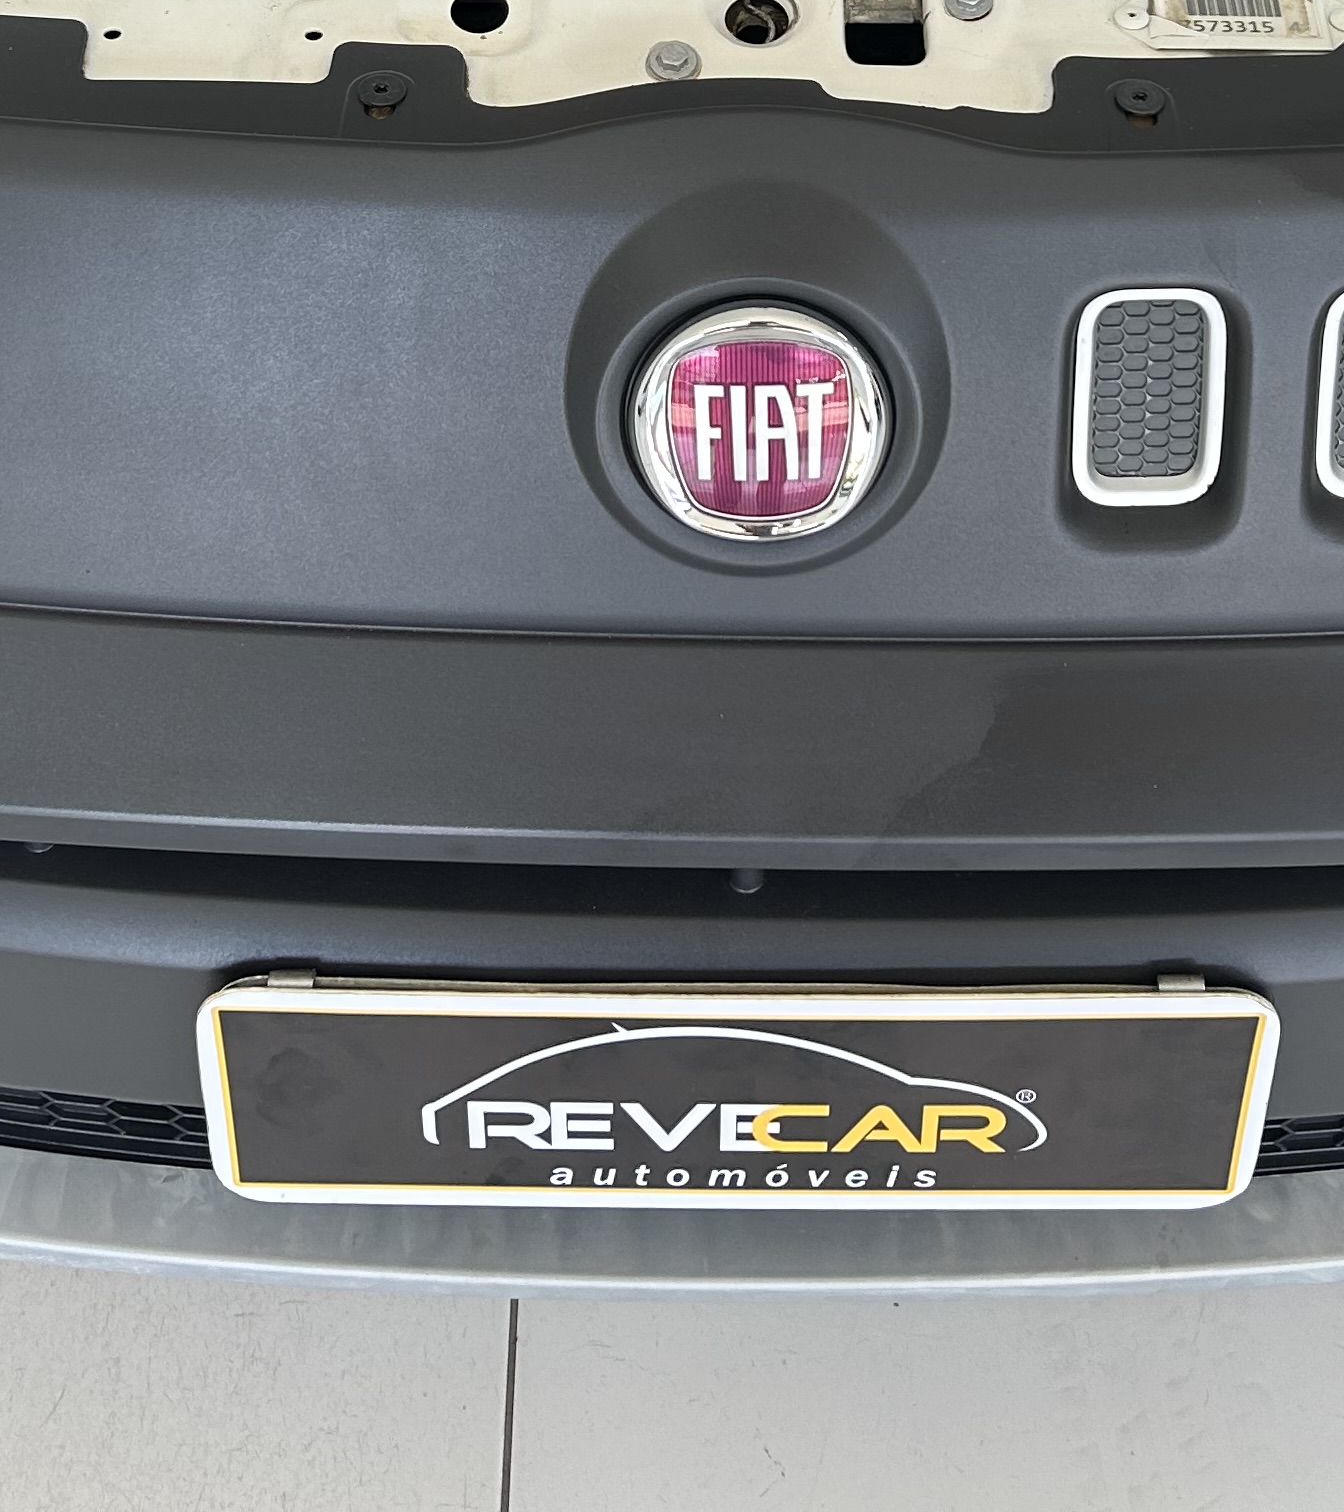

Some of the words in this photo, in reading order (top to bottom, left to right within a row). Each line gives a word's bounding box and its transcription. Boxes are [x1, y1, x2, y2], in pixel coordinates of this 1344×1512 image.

[693, 382, 835, 482] FIAT
[467, 1099, 1007, 1153] REVECAR
[549, 1163, 938, 1188] automóveis
